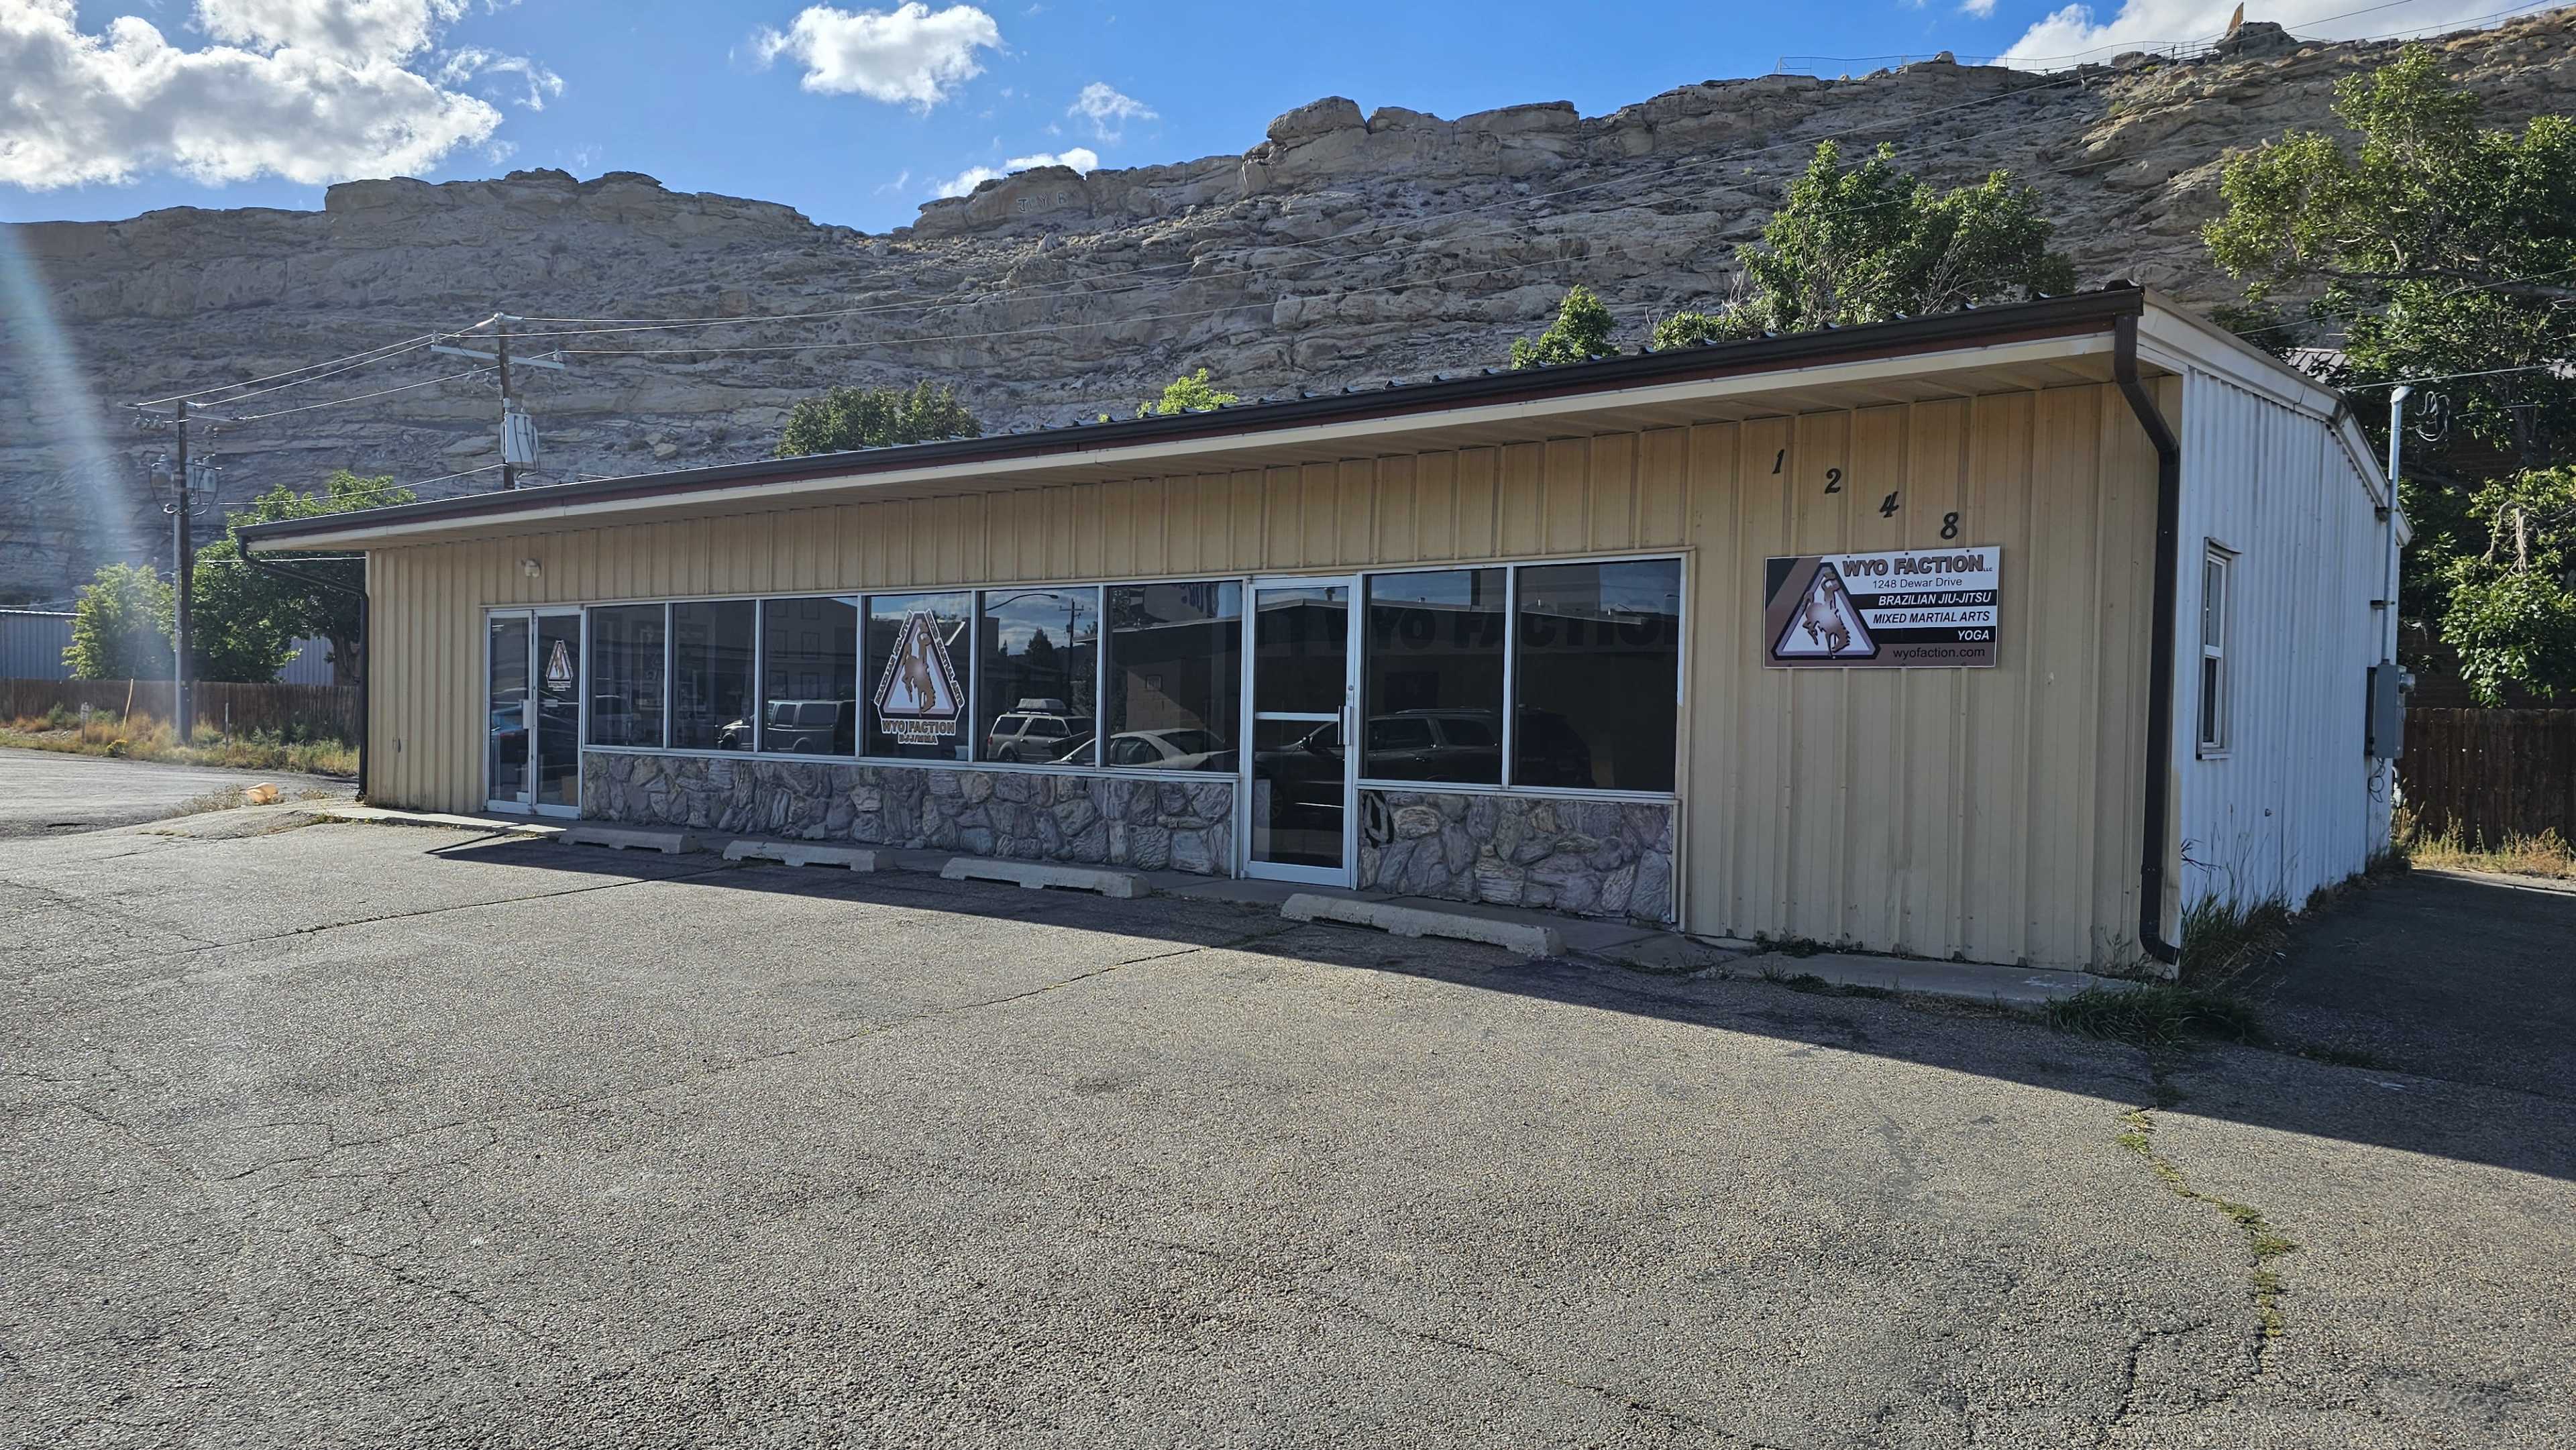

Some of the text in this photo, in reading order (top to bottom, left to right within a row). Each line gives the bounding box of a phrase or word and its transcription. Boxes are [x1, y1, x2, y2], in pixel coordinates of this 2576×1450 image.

[1772, 449, 1959, 539] 1 2 4 8
[1843, 559, 1888, 577] WYO
[1894, 555, 1984, 575] FACTION
[1873, 577, 1962, 589] 1248 Dewar Drive
[1878, 592, 1991, 606] BRAZILIAN JIU-JITSU
[1873, 611, 1990, 624] MIXED MARTIAL ARTS
[1958, 630, 1989, 640] YOGA
[1893, 647, 1985, 660] wyofaction.com
[881, 720, 955, 734] WYO FACTION
